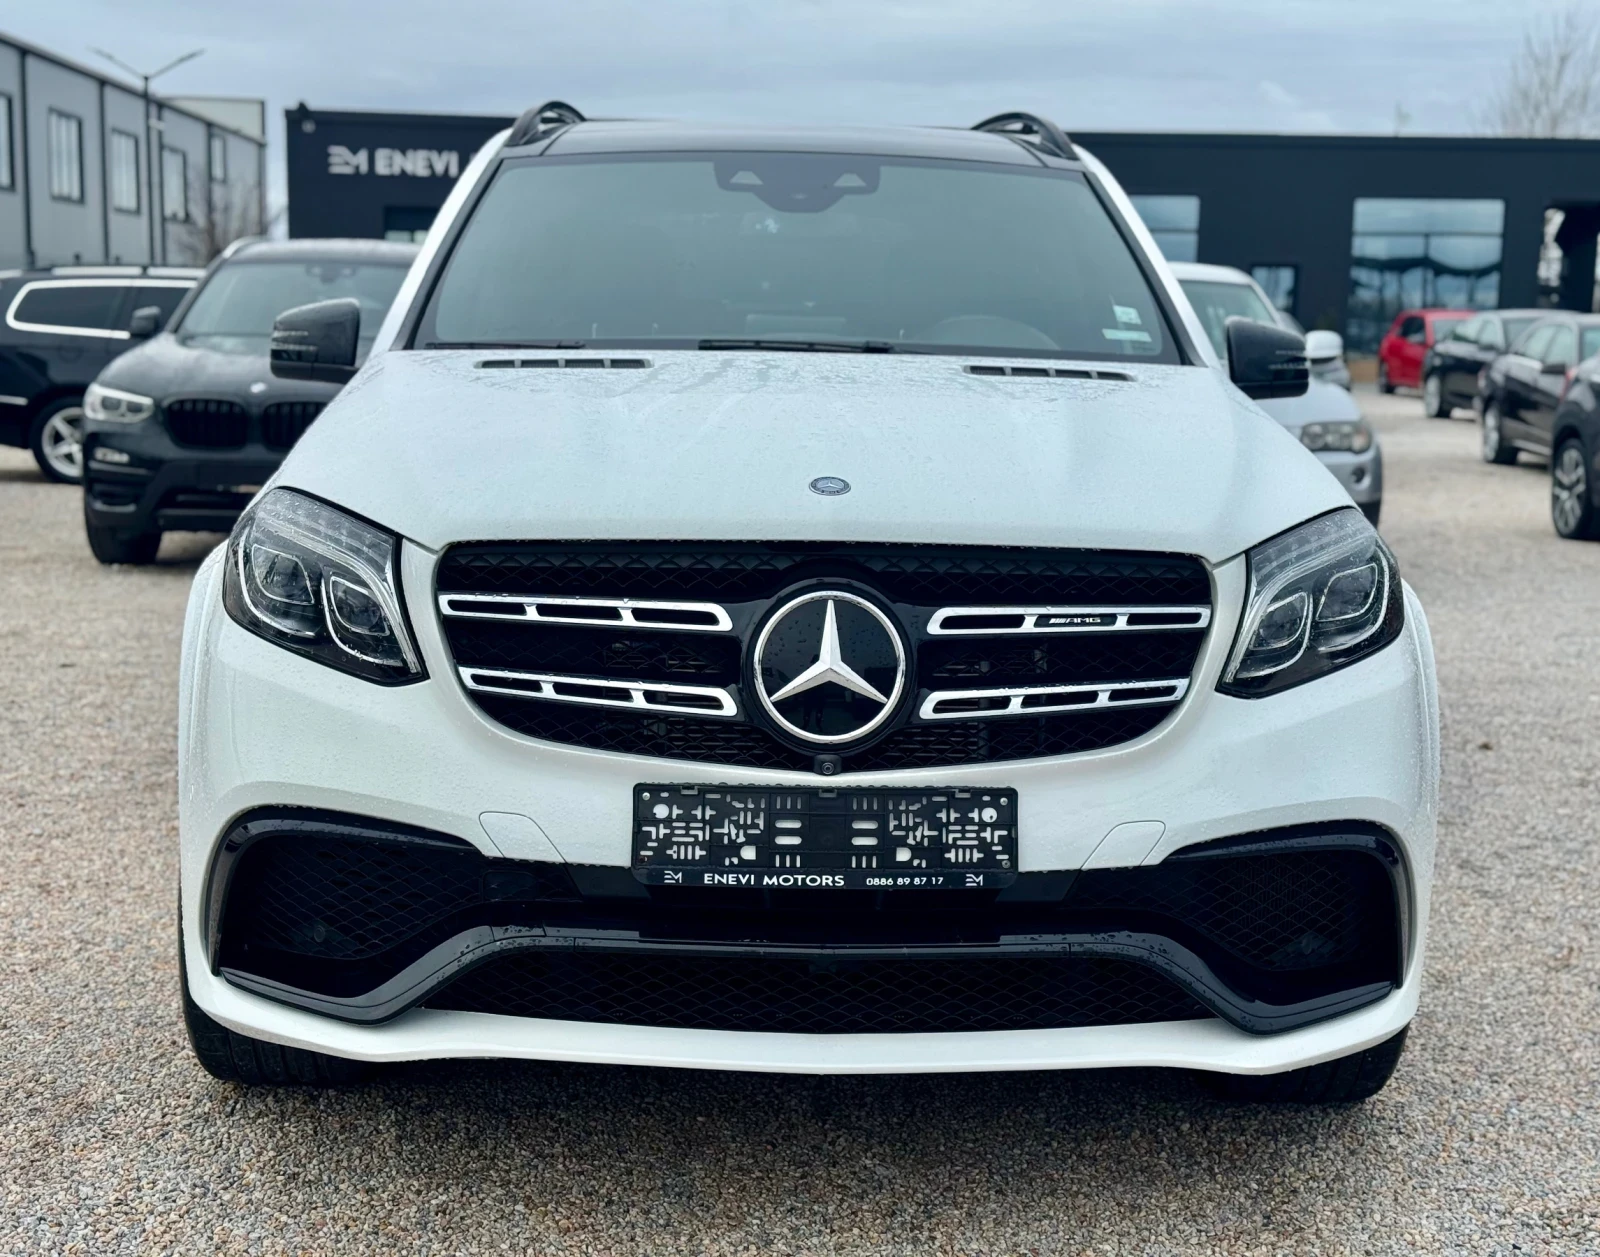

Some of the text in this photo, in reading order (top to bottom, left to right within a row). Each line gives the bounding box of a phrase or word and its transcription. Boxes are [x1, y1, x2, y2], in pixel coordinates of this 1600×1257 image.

[374, 147, 460, 178] ENEVI
[703, 873, 755, 885] ENEVI
[762, 874, 845, 887] MOTORS
[865, 877, 894, 886] 0886
[896, 877, 911, 886] 89
[913, 877, 927, 886] 87
[931, 876, 944, 885] 17
